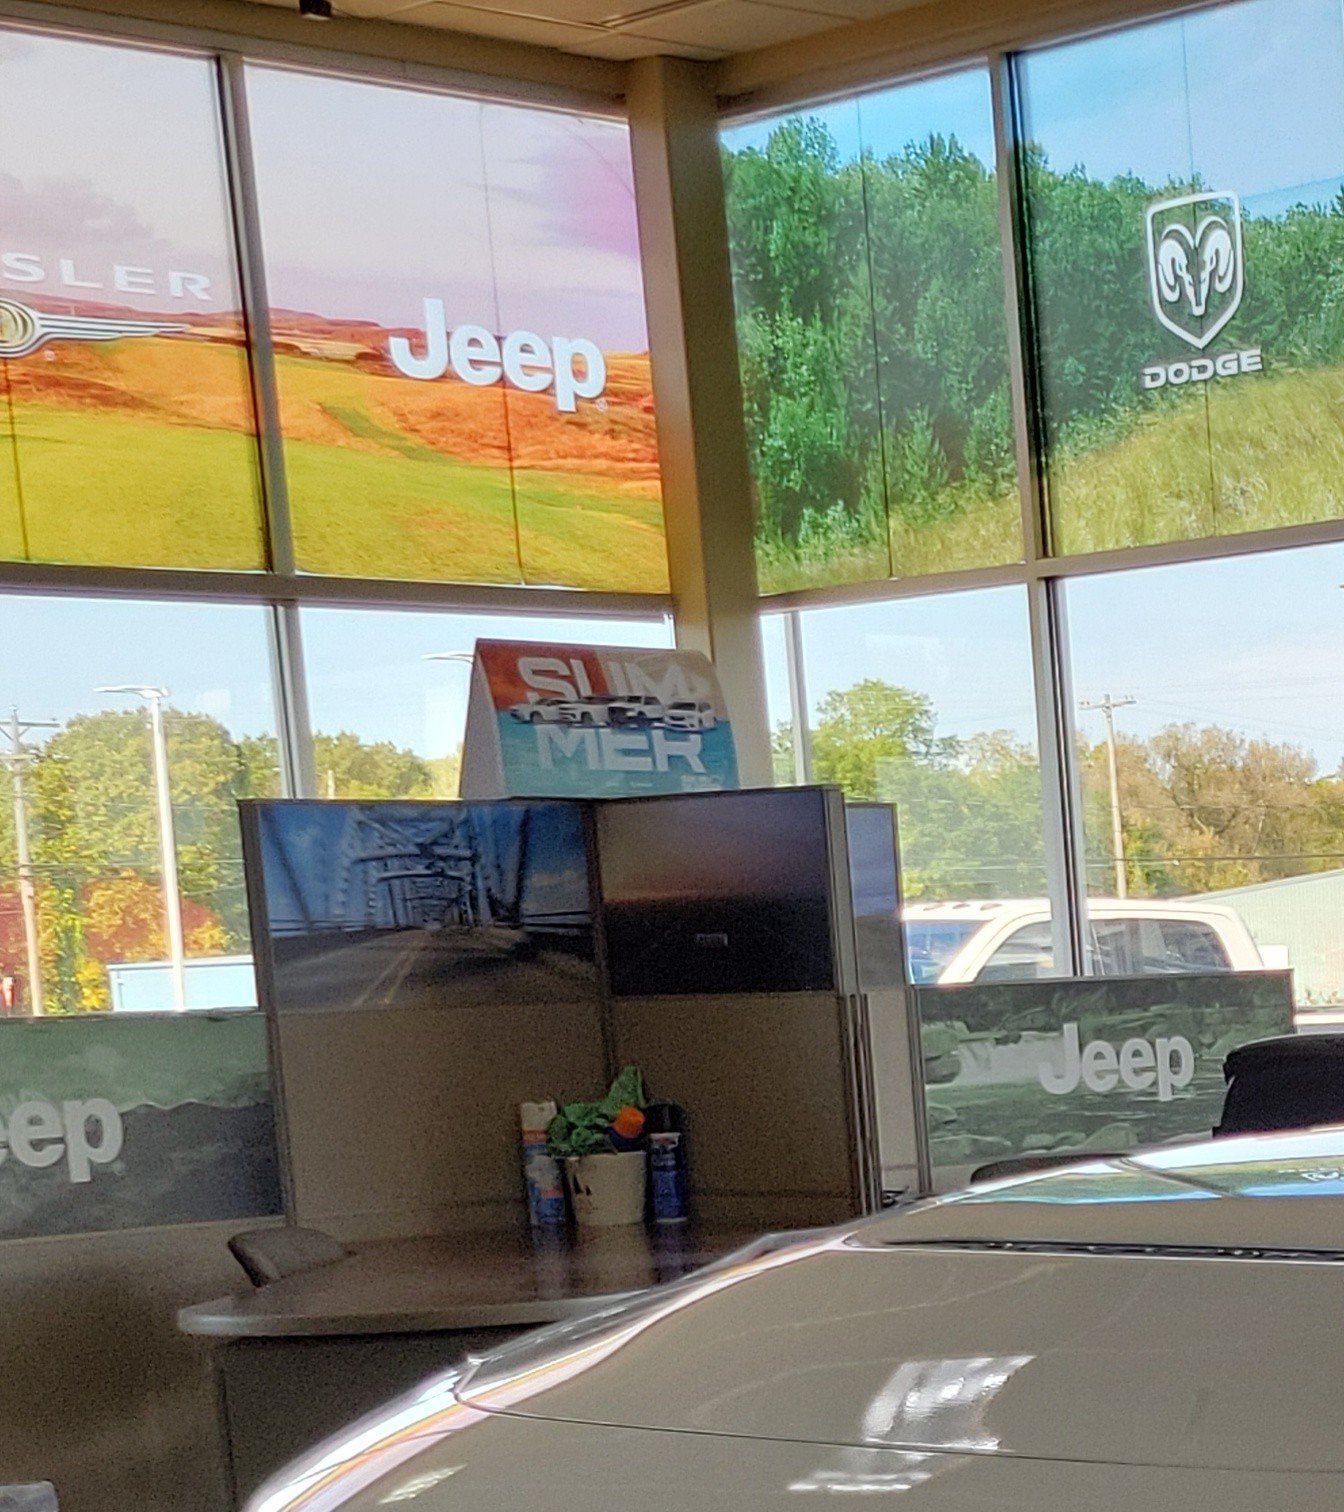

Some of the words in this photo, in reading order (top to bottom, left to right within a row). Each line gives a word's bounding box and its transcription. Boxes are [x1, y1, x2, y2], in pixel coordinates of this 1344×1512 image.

[1, 251, 213, 300] SLER
[388, 297, 606, 412] Jeep
[1144, 349, 1262, 388] DODGE
[1038, 1022, 1195, 1102] Jeep
[0, 1097, 124, 1184] ep
